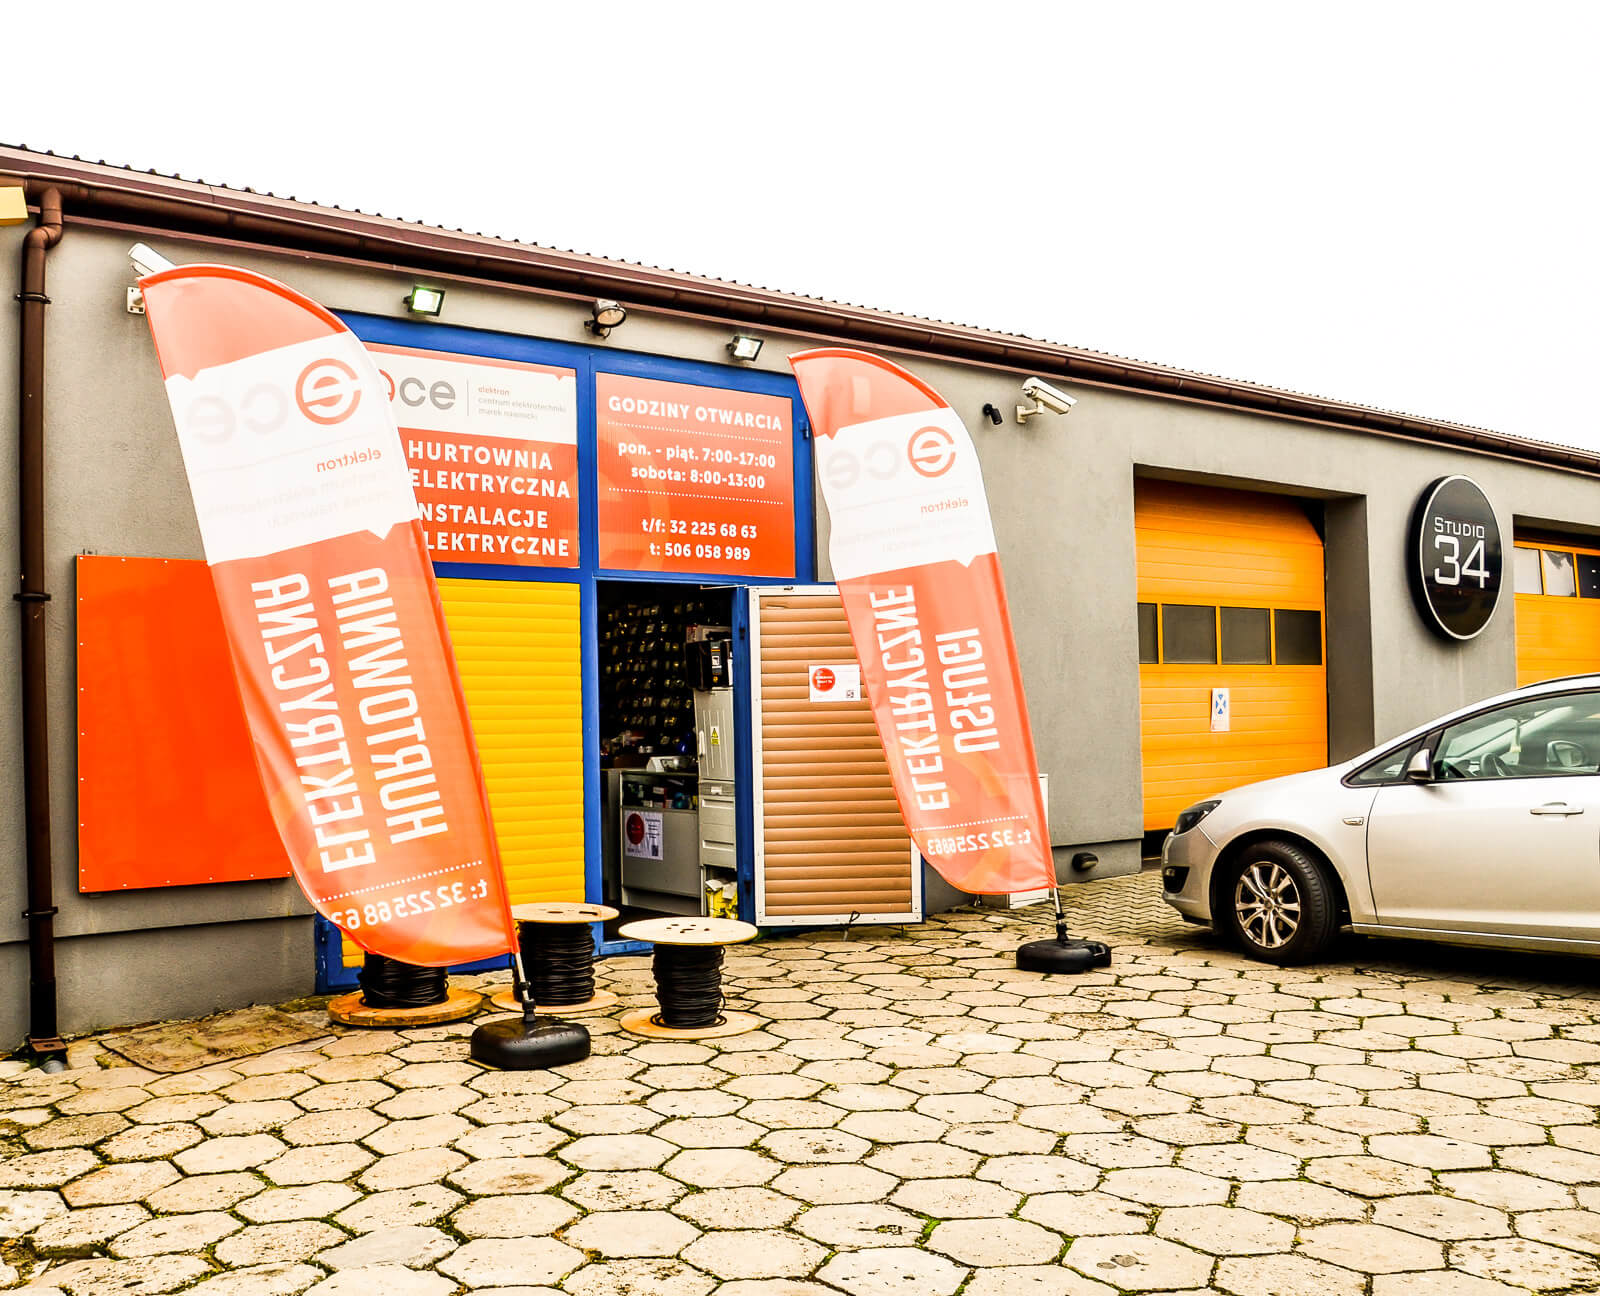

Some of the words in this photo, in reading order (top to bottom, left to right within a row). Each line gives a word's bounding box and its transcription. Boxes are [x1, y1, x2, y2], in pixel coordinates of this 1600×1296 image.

[378, 369, 456, 410] ce
[478, 385, 510, 396] elektron
[608, 395, 690, 419] GODZINY
[695, 406, 782, 431] OTWARCIA
[408, 440, 553, 471] HURTOWNIA
[618, 442, 651, 457] pon.
[666, 444, 699, 462] piąt.
[702, 448, 776, 468] 7:00-17:00
[408, 468, 571, 499] ELEKTRYCZNA
[631, 465, 686, 481] sobota:
[690, 469, 765, 489] 8:00-13:00
[418, 502, 549, 529] NSTALACJE
[641, 518, 666, 533] t/f:
[670, 520, 687, 534] 32
[690, 521, 716, 536] 225
[720, 523, 737, 538] 68
[741, 525, 757, 539] 63
[423, 531, 569, 557] LEKTRYCZNE
[649, 542, 661, 556] t:
[665, 542, 691, 557] 506
[695, 544, 721, 559] 058
[725, 546, 751, 561] 989
[1434, 534, 1490, 589] 34
